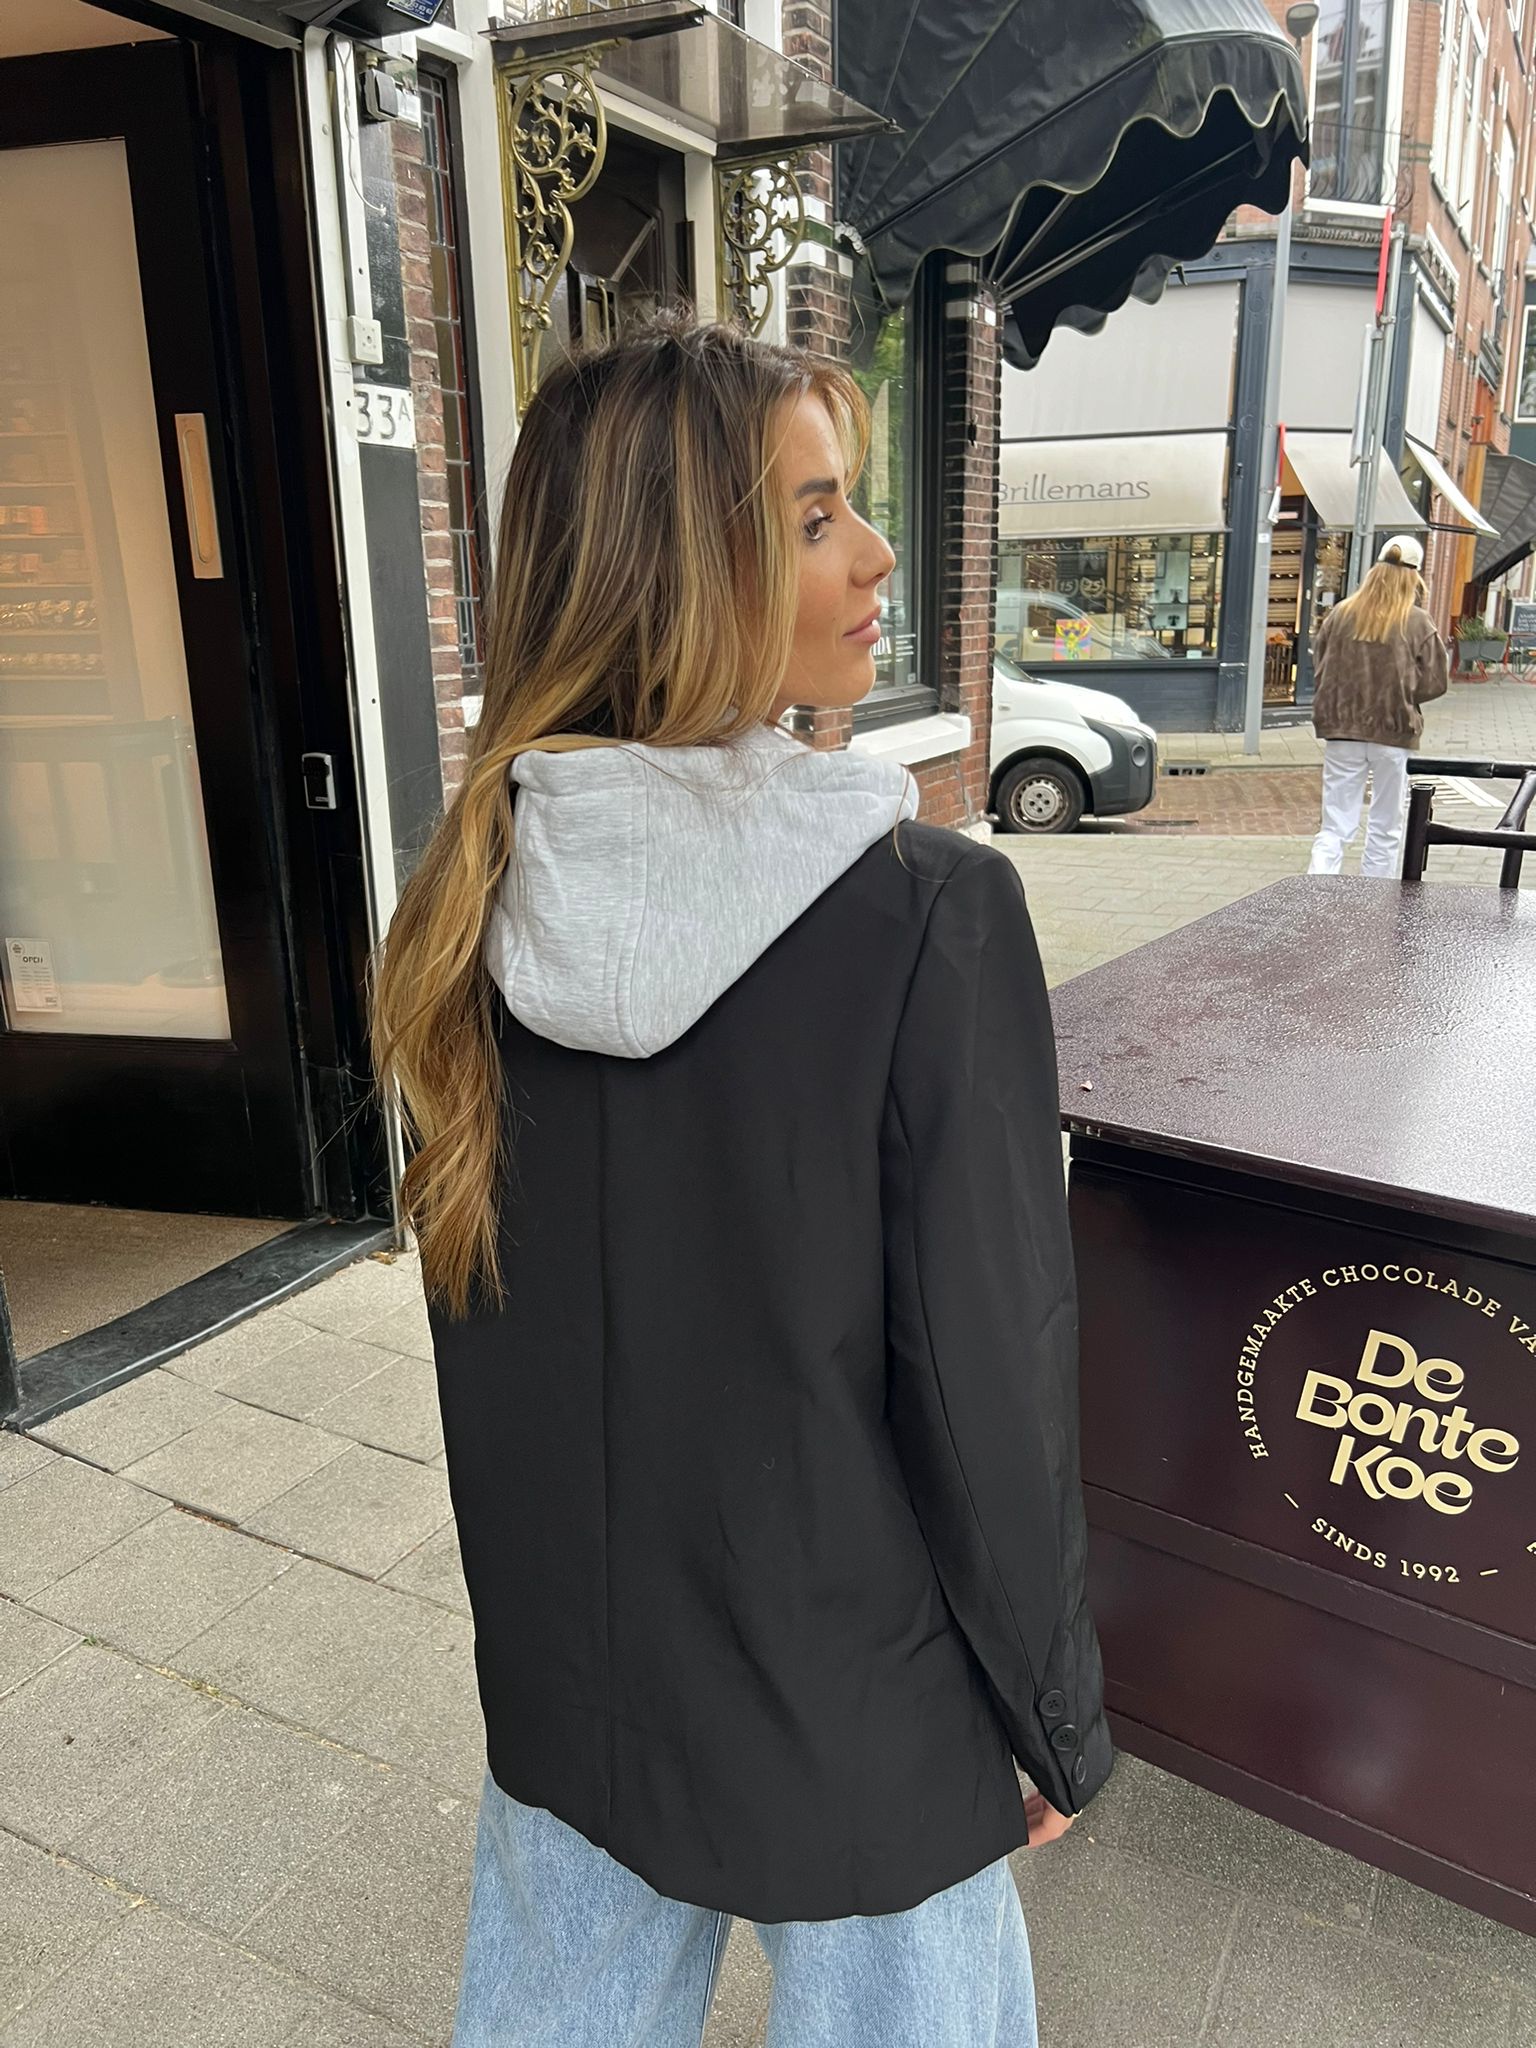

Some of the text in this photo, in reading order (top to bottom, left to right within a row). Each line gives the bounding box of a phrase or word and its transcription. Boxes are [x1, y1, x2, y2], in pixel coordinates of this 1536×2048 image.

[1237, 1264, 1536, 1459] HANDGEMAAKTE CHOCOLADE VA
[1356, 1329, 1464, 1402] De
[1296, 1369, 1520, 1473] Bonte
[1329, 1434, 1474, 1515] Koe
[1311, 1518, 1460, 1583] SINDS 1992
